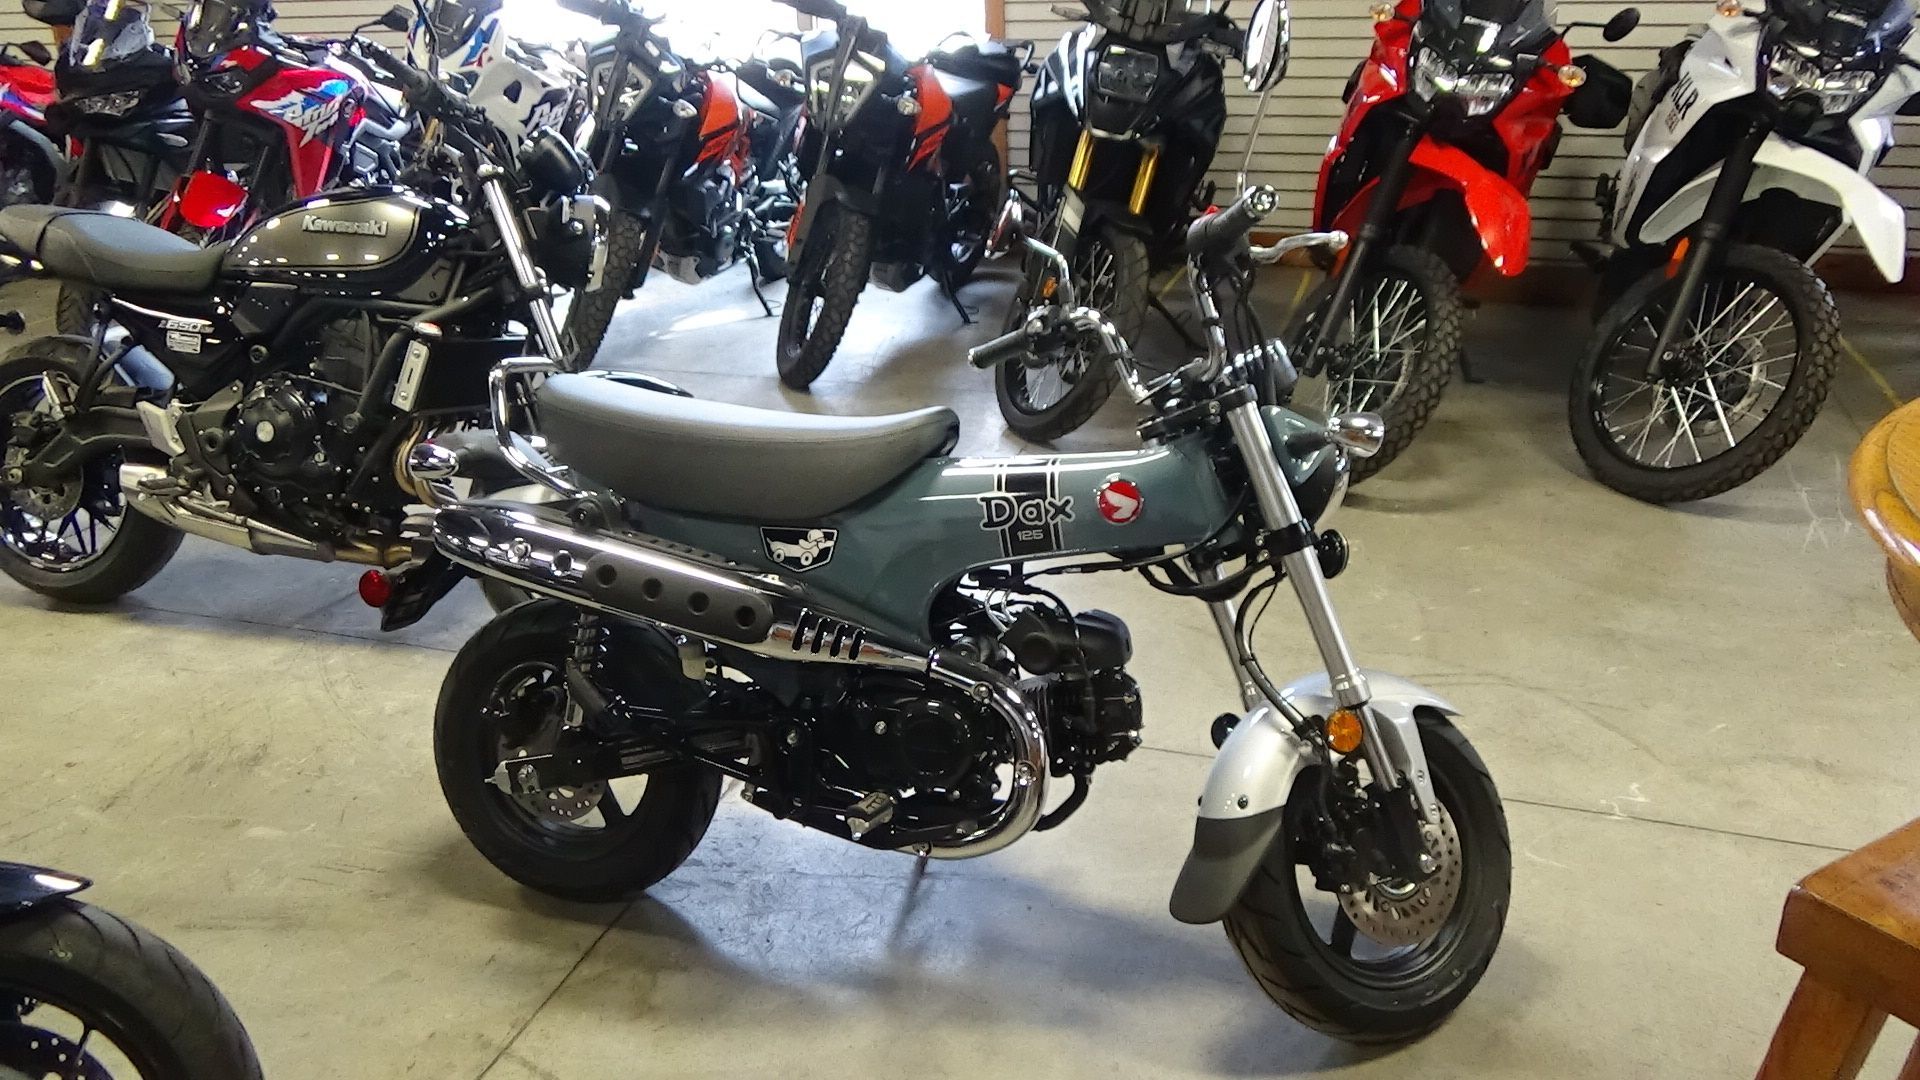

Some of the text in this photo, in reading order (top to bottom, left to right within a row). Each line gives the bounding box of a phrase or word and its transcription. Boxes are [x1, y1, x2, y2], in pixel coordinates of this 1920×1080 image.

[1671, 71, 1699, 120] KLR
[302, 214, 388, 236] Kawasaki
[977, 495, 1076, 531] Dax
[1016, 529, 1044, 541] 125
